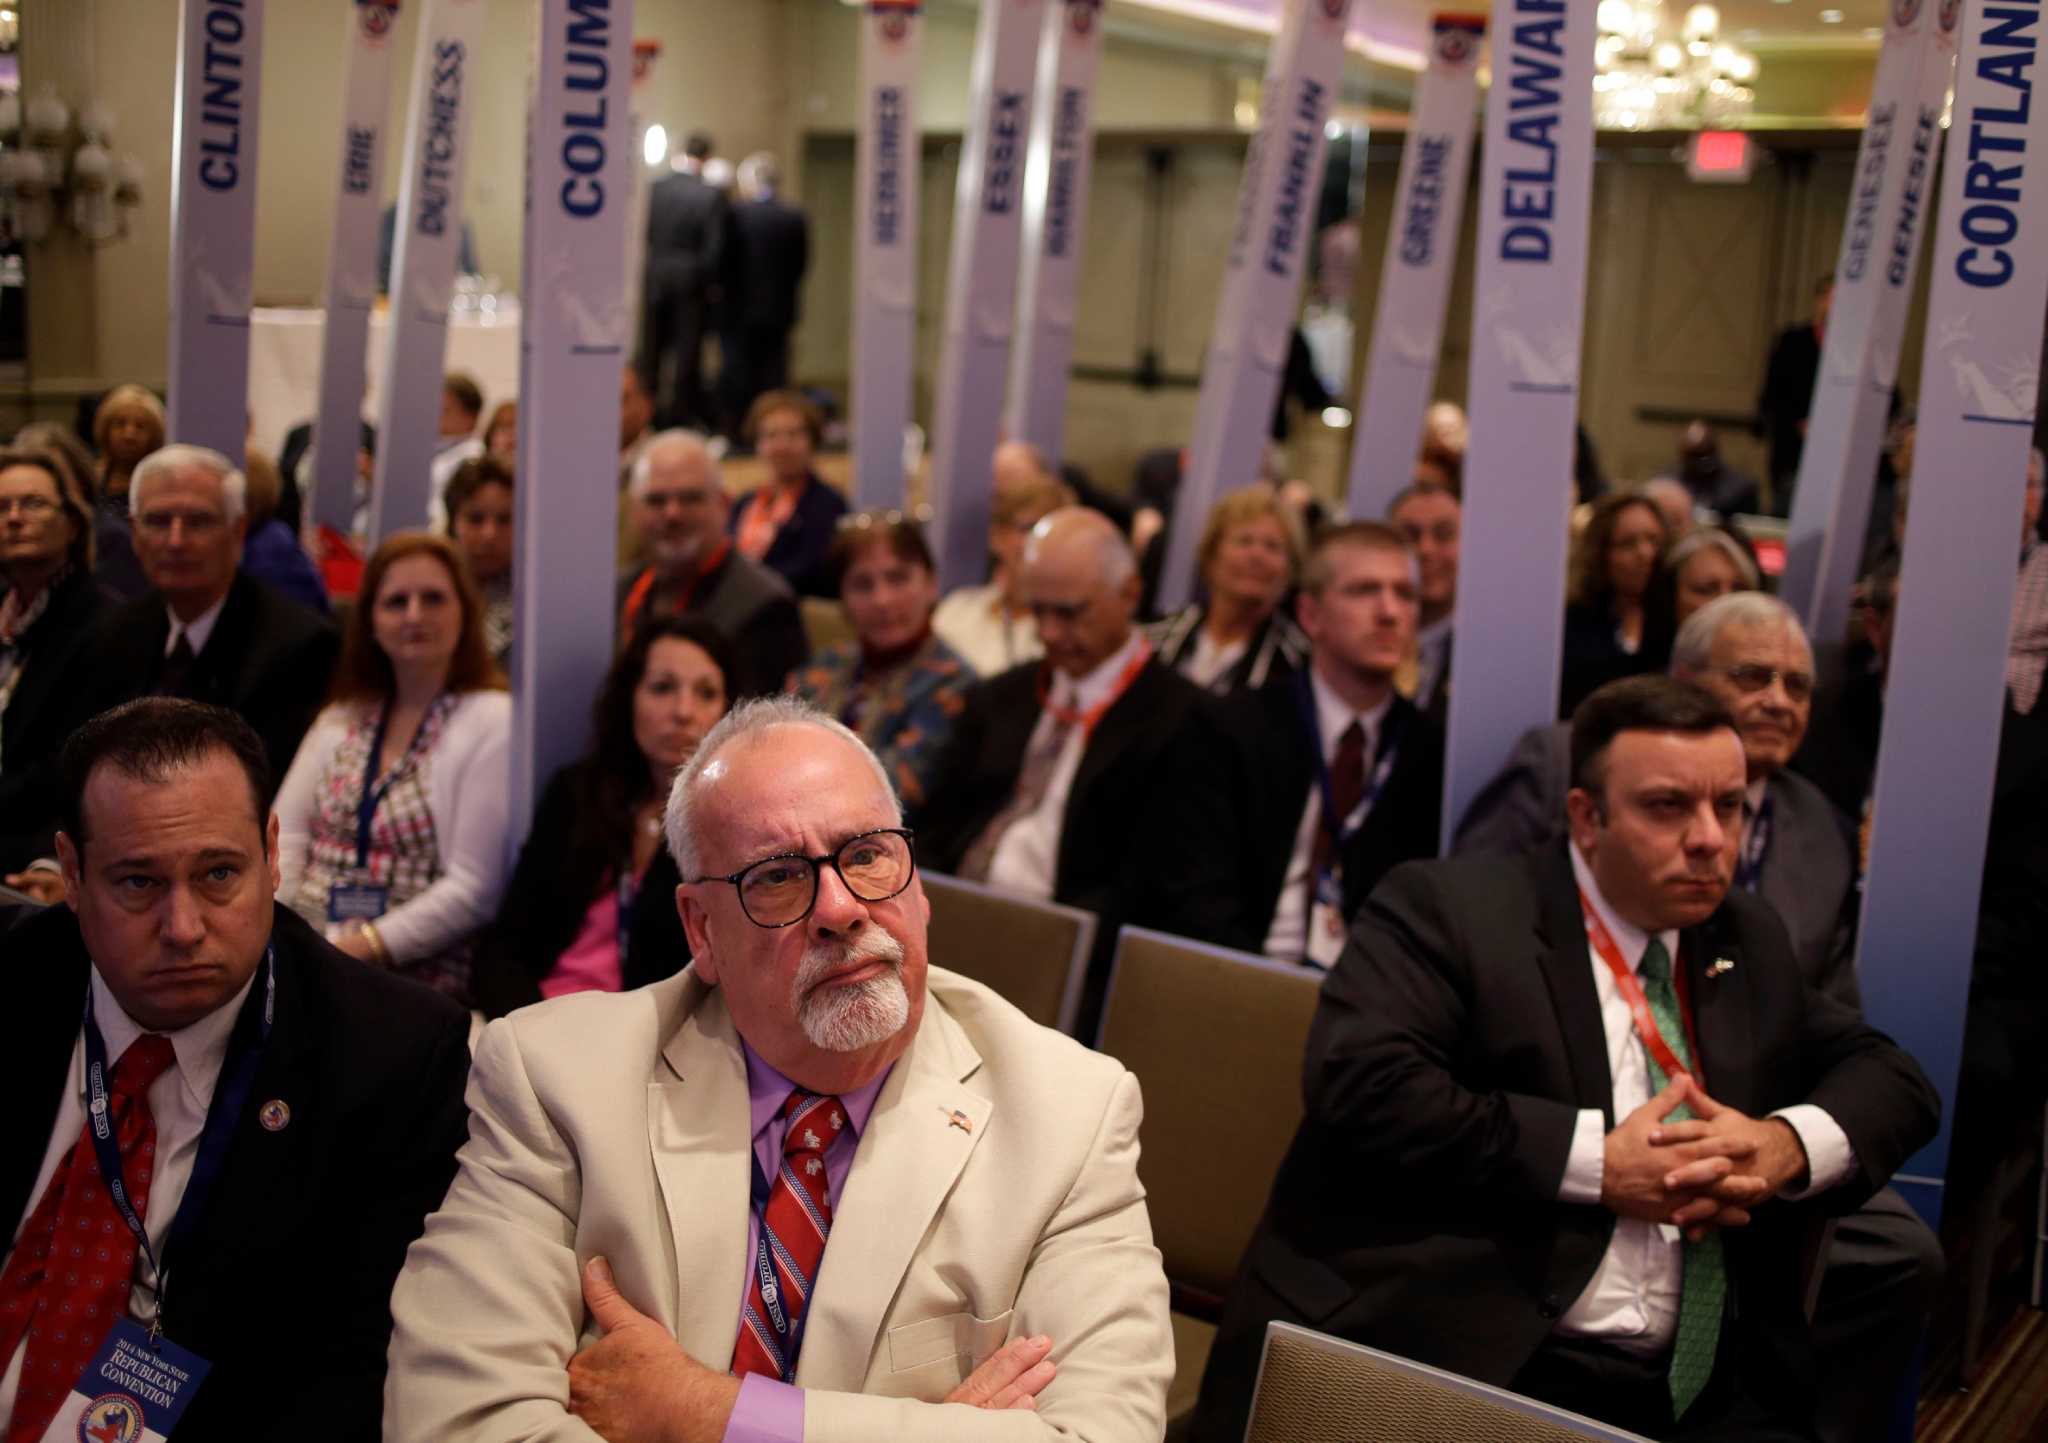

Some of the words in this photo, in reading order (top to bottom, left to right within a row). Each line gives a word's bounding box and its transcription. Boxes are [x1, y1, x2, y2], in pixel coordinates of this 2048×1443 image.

[200, 0, 245, 193] CLINTO
[418, 39, 466, 238] DUTCHESS
[561, 0, 610, 218] COLUM
[1956, 0, 2041, 287] CORTLAN
[1844, 104, 1896, 283] GENESEE
[1886, 107, 1938, 288] GENESEE
[101, 1362, 175, 1409] CONVENTION
[110, 1349, 181, 1393] REPUBLICAN
